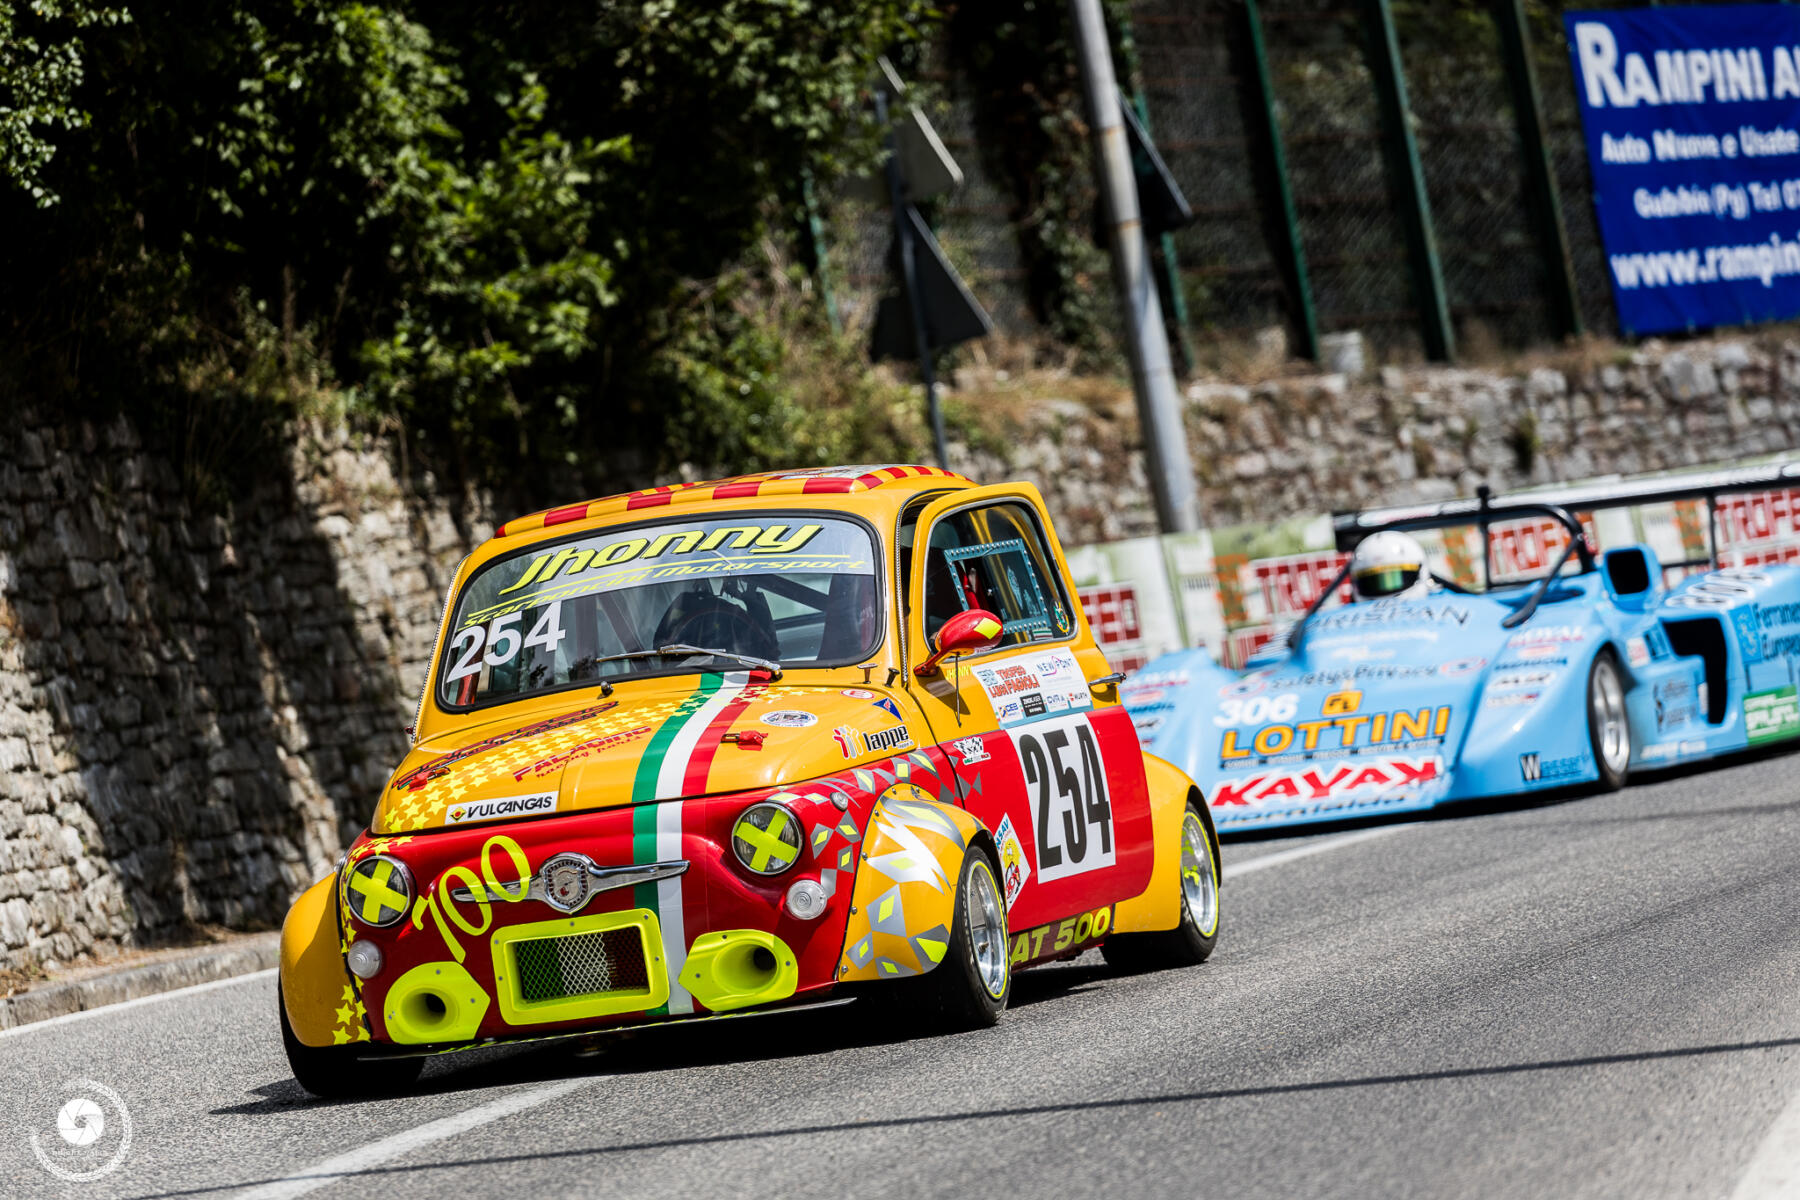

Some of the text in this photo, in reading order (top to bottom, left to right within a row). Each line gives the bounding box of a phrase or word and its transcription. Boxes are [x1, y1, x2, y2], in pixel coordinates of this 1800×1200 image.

[1574, 21, 1800, 107] RAMPINI A
[1601, 131, 1650, 164] Auto
[1721, 133, 1738, 159] e
[1610, 231, 1800, 289] www.rampin
[499, 524, 824, 596] Jhonny
[446, 600, 566, 684] 254
[1214, 693, 1299, 728] 306
[1220, 707, 1452, 761] LOTTINI
[862, 726, 909, 752] lappe
[467, 796, 553, 819] VULCANGAS
[1019, 724, 1112, 870] 254
[1211, 761, 1438, 807] KAYAK
[1008, 906, 1111, 967] AT 500
